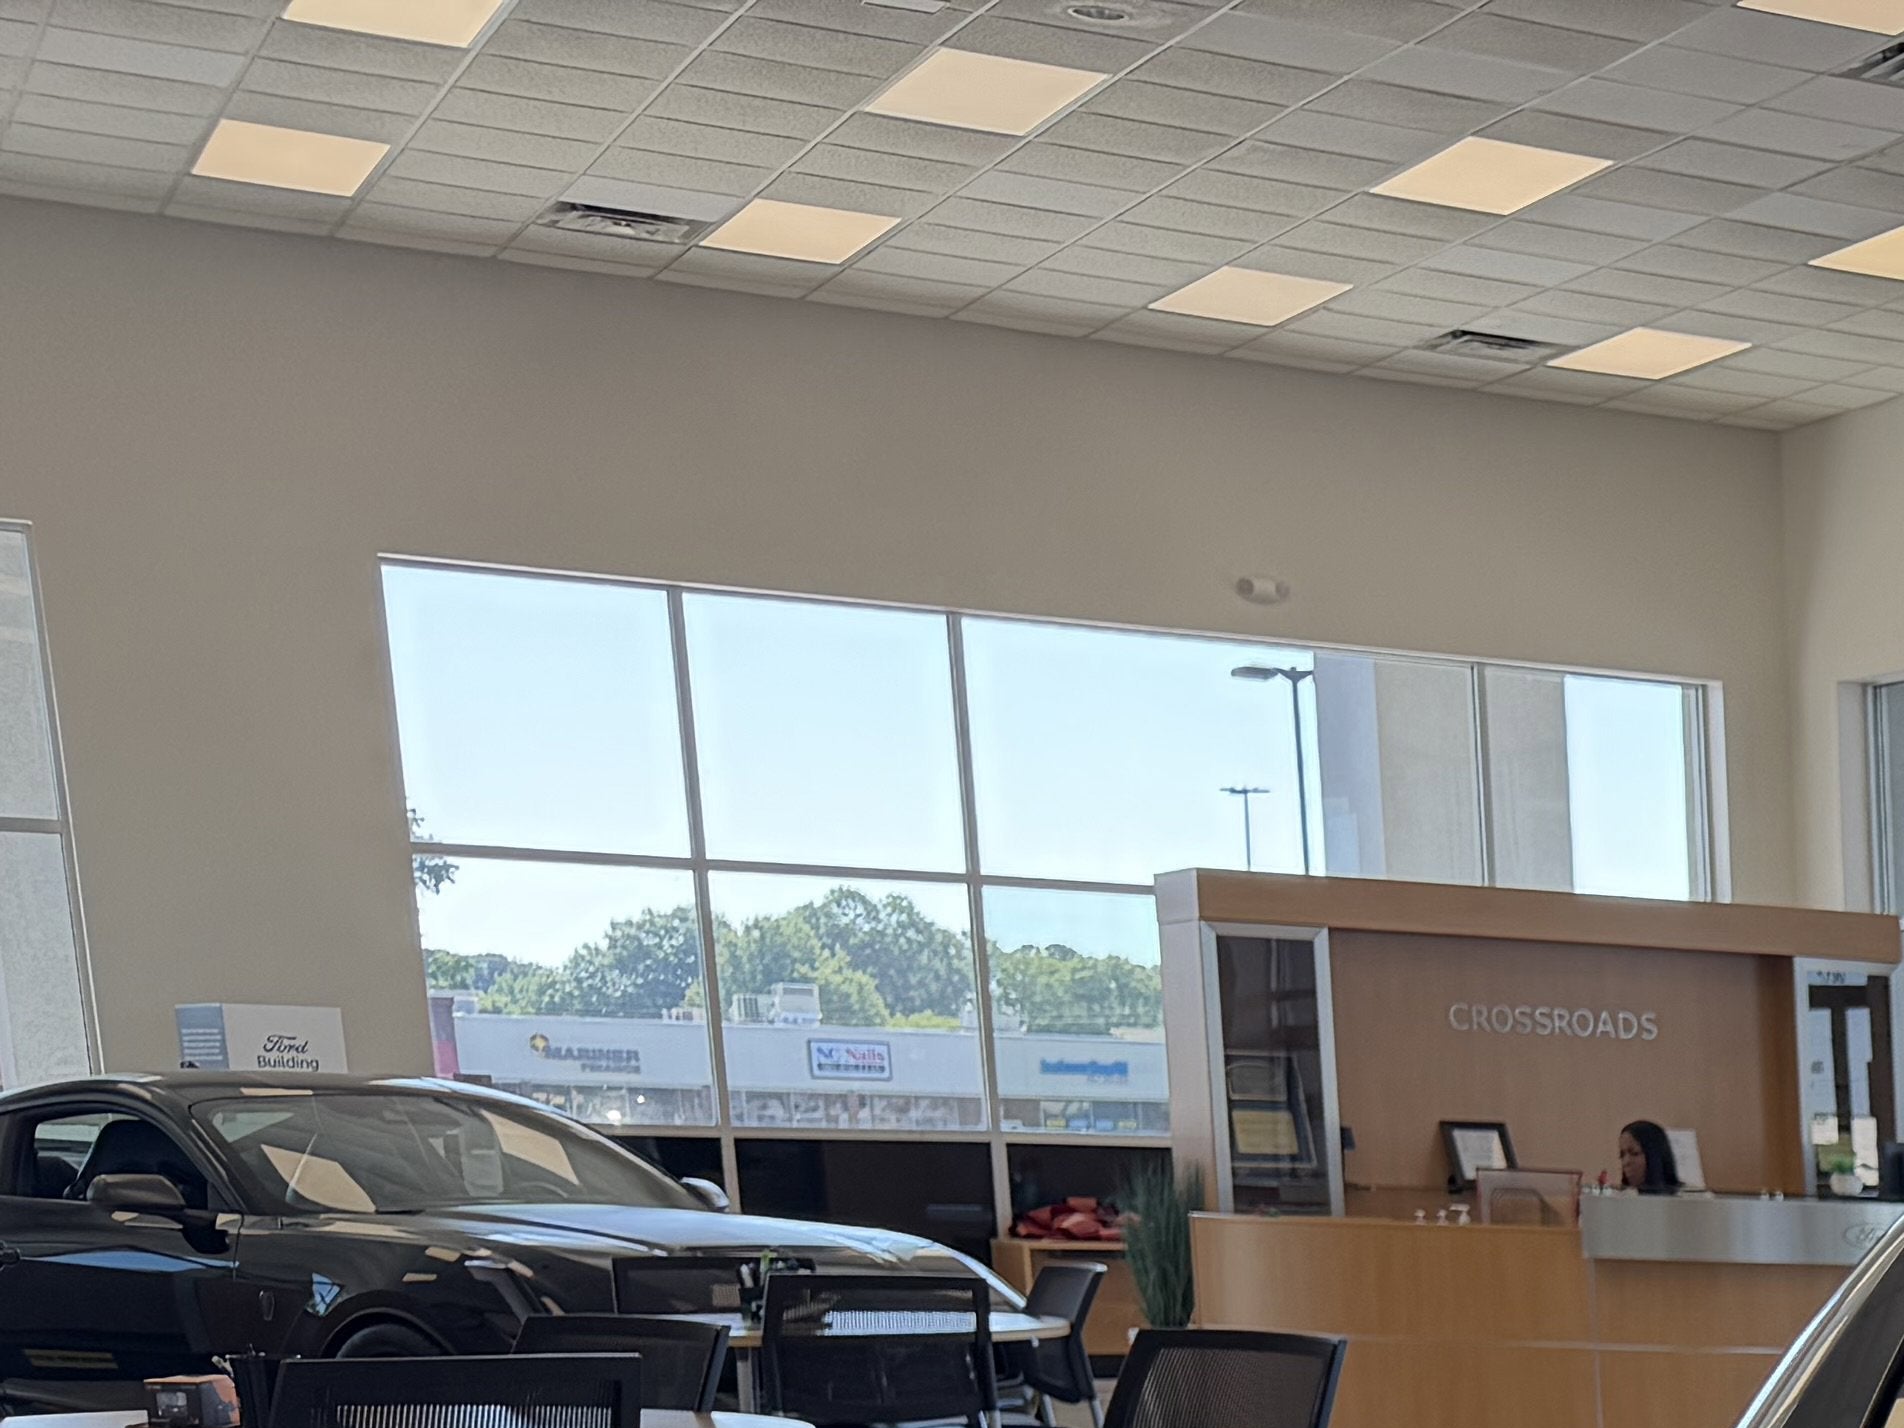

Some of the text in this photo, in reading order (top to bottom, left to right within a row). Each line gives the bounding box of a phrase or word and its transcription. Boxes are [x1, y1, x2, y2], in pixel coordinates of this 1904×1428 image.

[1449, 1002, 1659, 1040] CROSSROADS
[263, 1034, 309, 1054] Ford
[257, 1055, 320, 1072] Building
